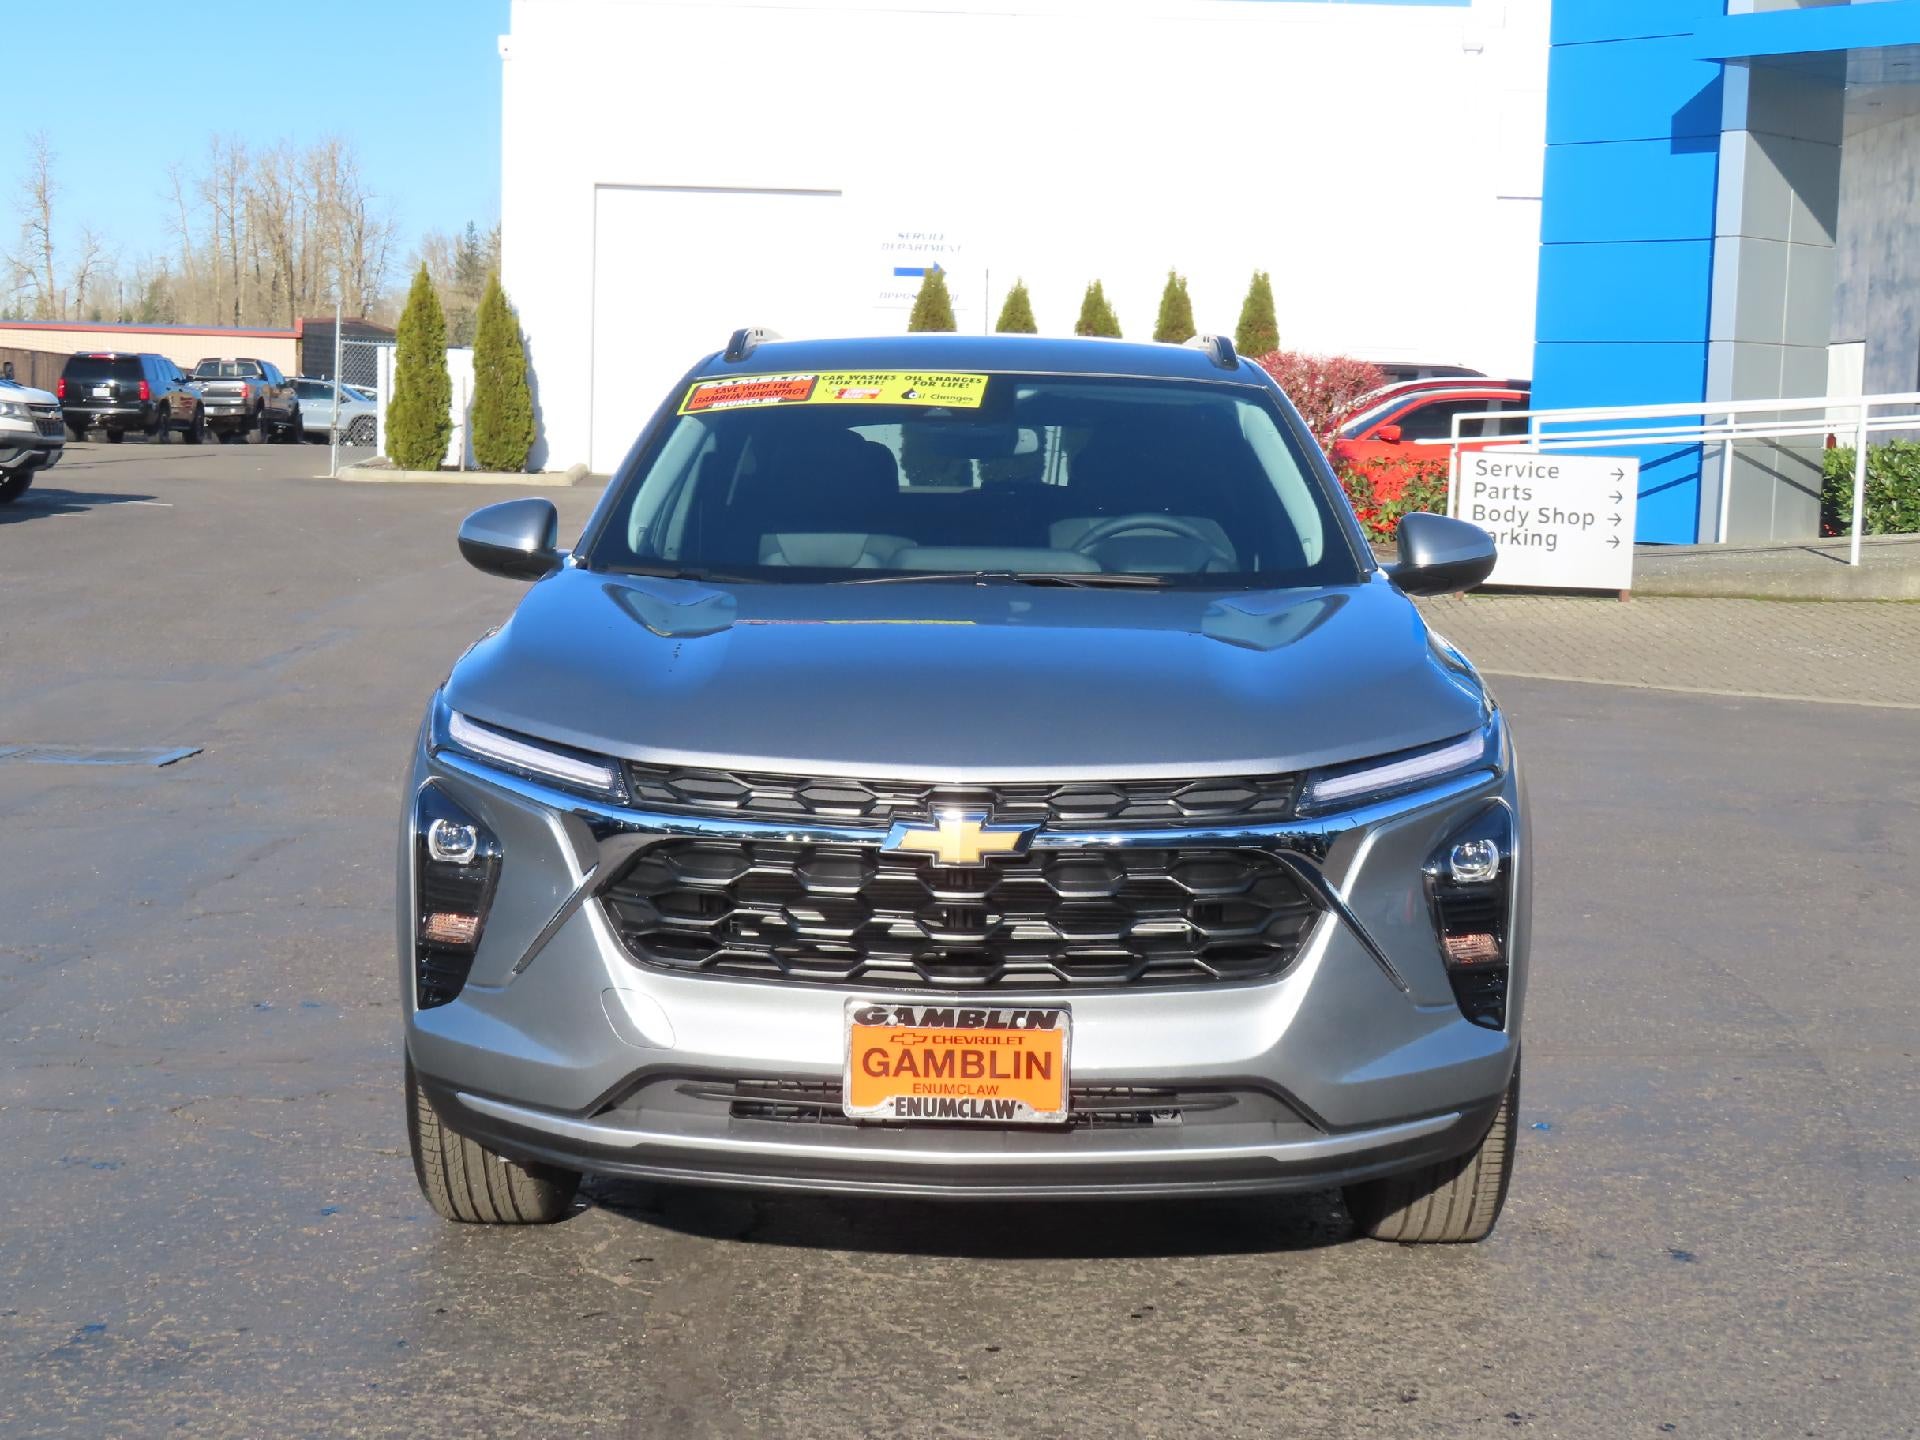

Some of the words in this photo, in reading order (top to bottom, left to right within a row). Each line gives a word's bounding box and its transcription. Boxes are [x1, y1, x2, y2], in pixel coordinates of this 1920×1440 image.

[714, 387, 740, 395] SAVE
[742, 383, 771, 392] WITH
[928, 376, 983, 384] CHANGES
[744, 388, 808, 398] ADVANTAGE
[930, 394, 974, 402] Changes
[1475, 459, 1560, 479] Service
[1473, 482, 1533, 501] Parts
[1472, 504, 1530, 528] Body
[1538, 507, 1595, 531] Shop
[1488, 528, 1558, 552] arking
[853, 1006, 1060, 1030] GAMBLIN
[932, 1035, 1026, 1045] CHEVROLET
[862, 1047, 1052, 1080] GAMBLIN
[912, 1083, 1000, 1096] ENUMCLAW
[895, 1096, 1017, 1119] ENUMCLAW
